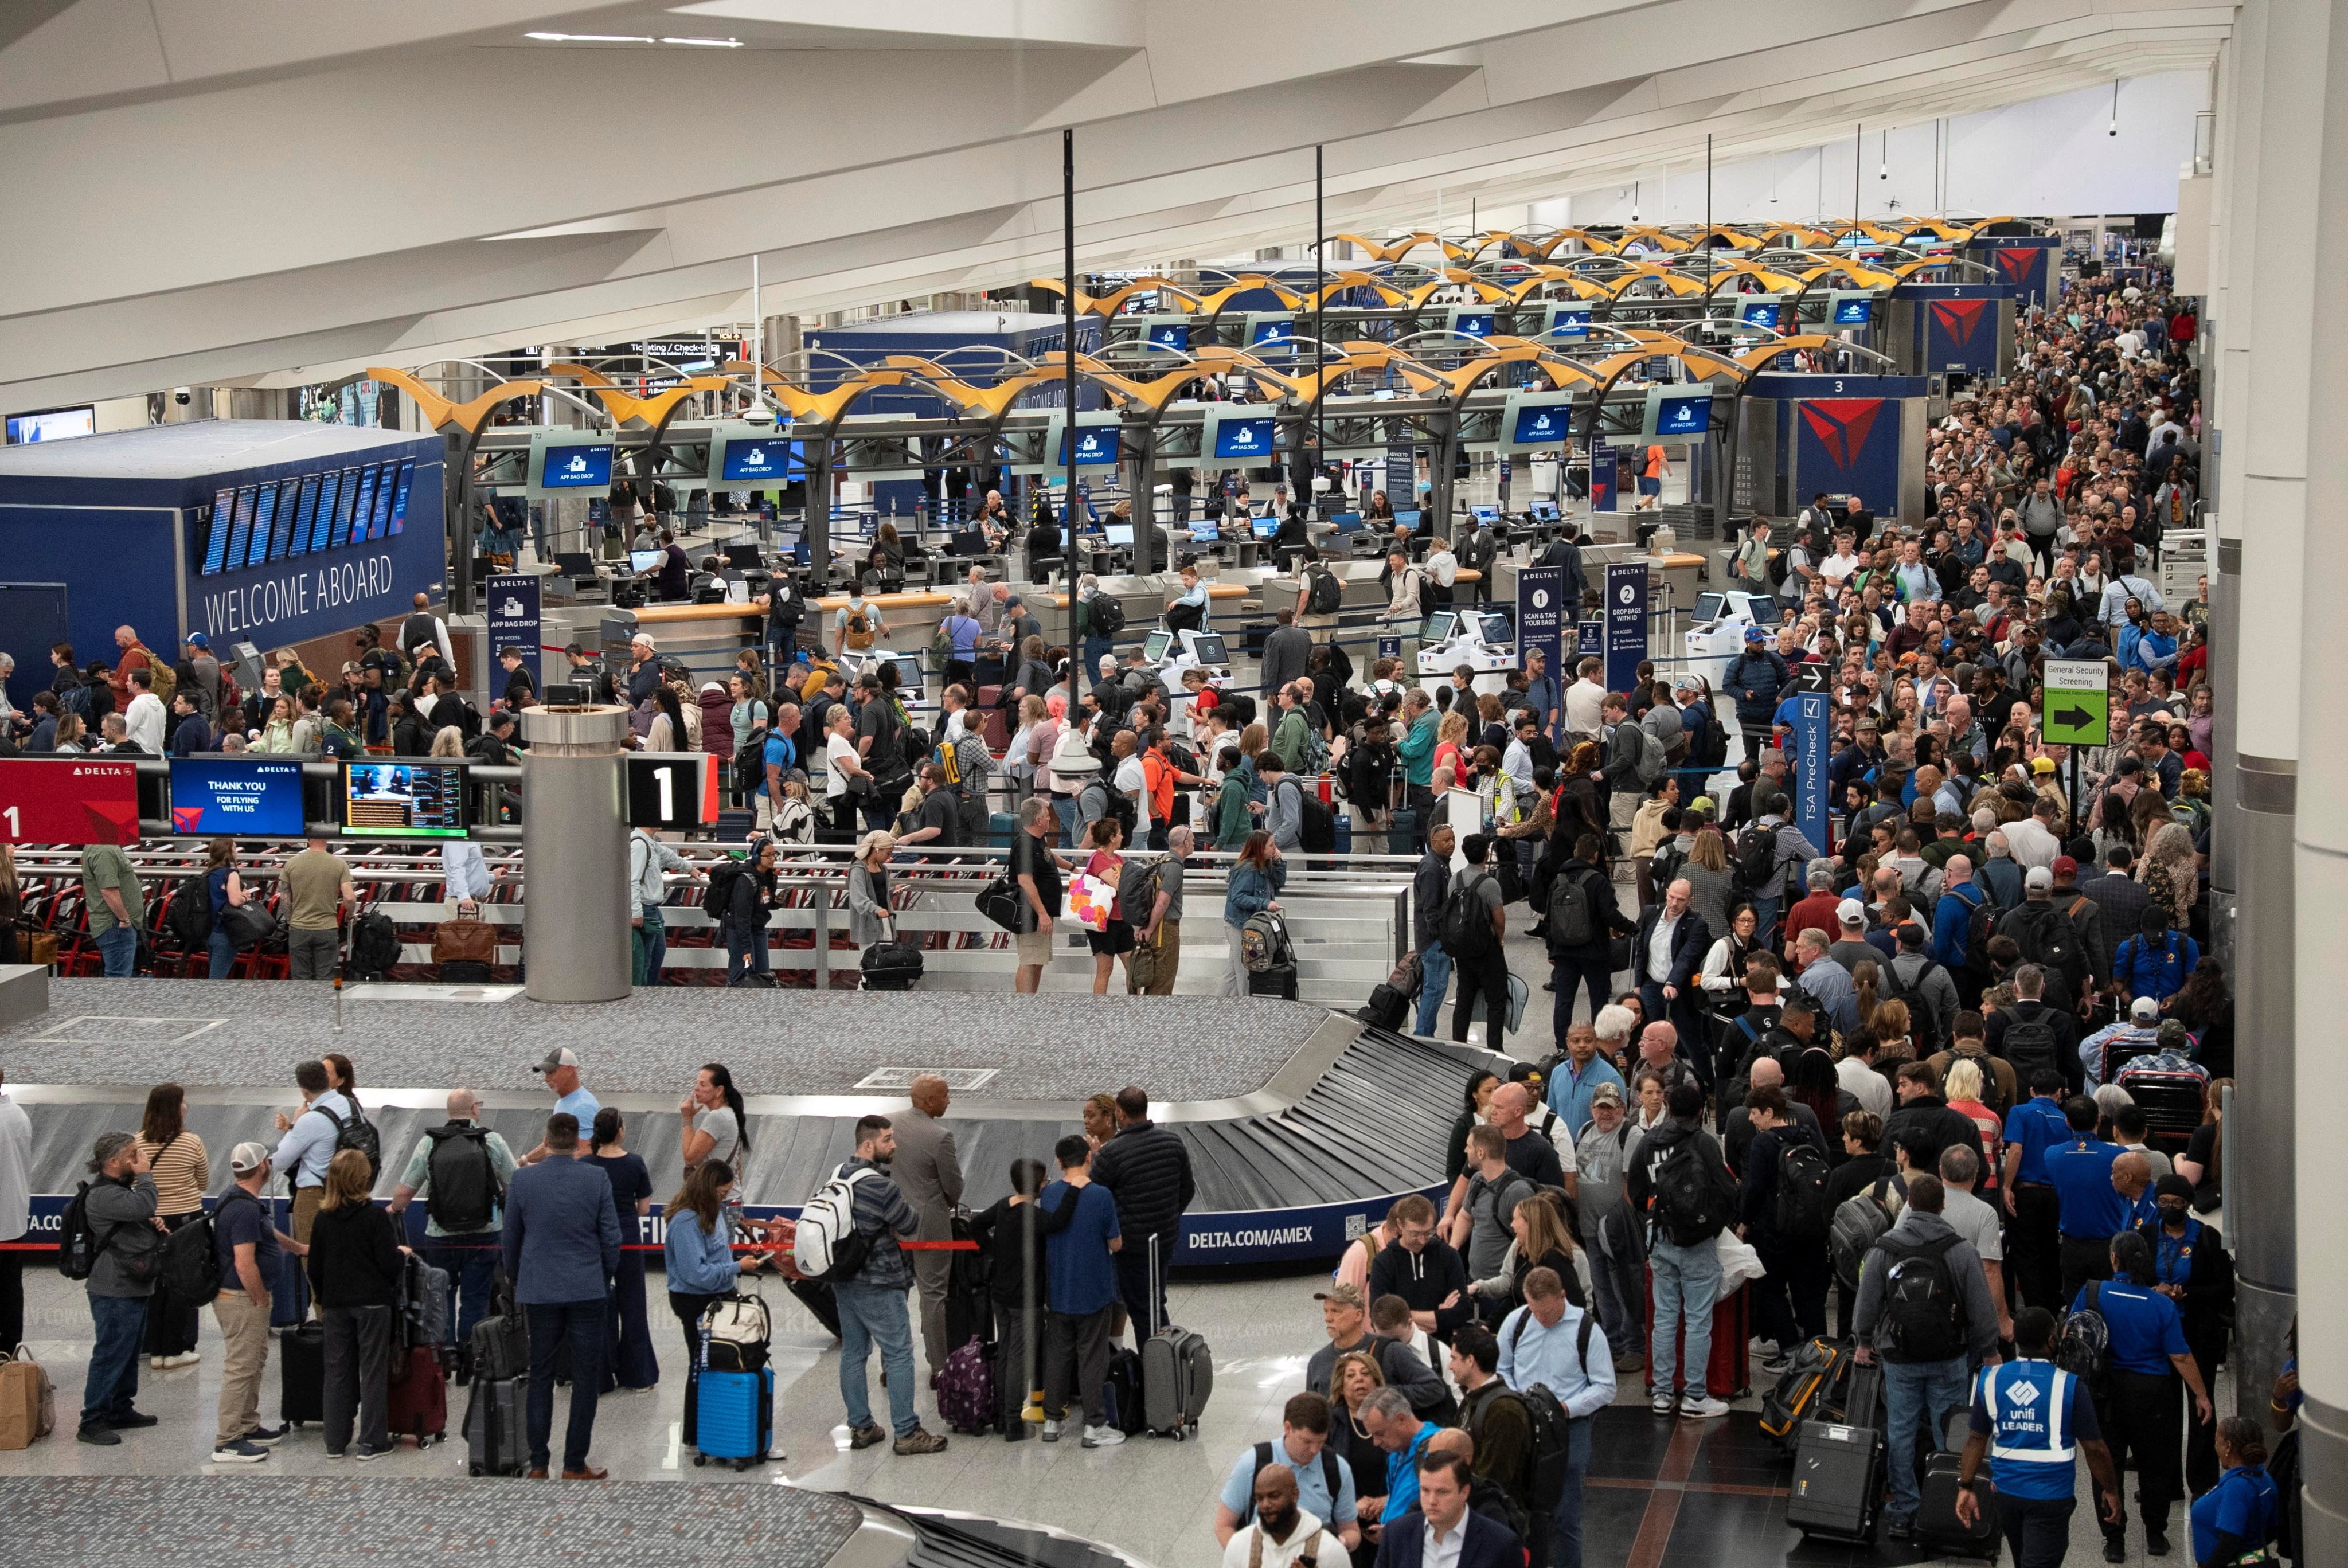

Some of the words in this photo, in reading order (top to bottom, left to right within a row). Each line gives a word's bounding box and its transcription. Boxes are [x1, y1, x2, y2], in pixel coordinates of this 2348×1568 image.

[1954, 288, 1960, 296] 2
[631, 343, 665, 352] Ticeting
[1835, 381, 1843, 392] 3
[205, 574, 308, 636] WELCOME
[316, 555, 392, 610] ABOARD
[1538, 593, 1542, 604] 1
[1624, 589, 1630, 600] 2
[2048, 665, 2074, 674] General
[2076, 666, 2104, 677] Security
[2058, 677, 2093, 688] Screening
[327, 745, 334, 754] 2
[208, 781, 243, 790] THANK
[244, 782, 266, 791] YOU
[654, 767, 673, 821] 1
[1806, 795, 1815, 821] TSA
[2, 806, 19, 838] 1
[1189, 1226, 1313, 1249] DELTA.COM/AMEX
[2010, 1408, 2035, 1421] unifi
[2002, 1421, 2044, 1432] LEADER
